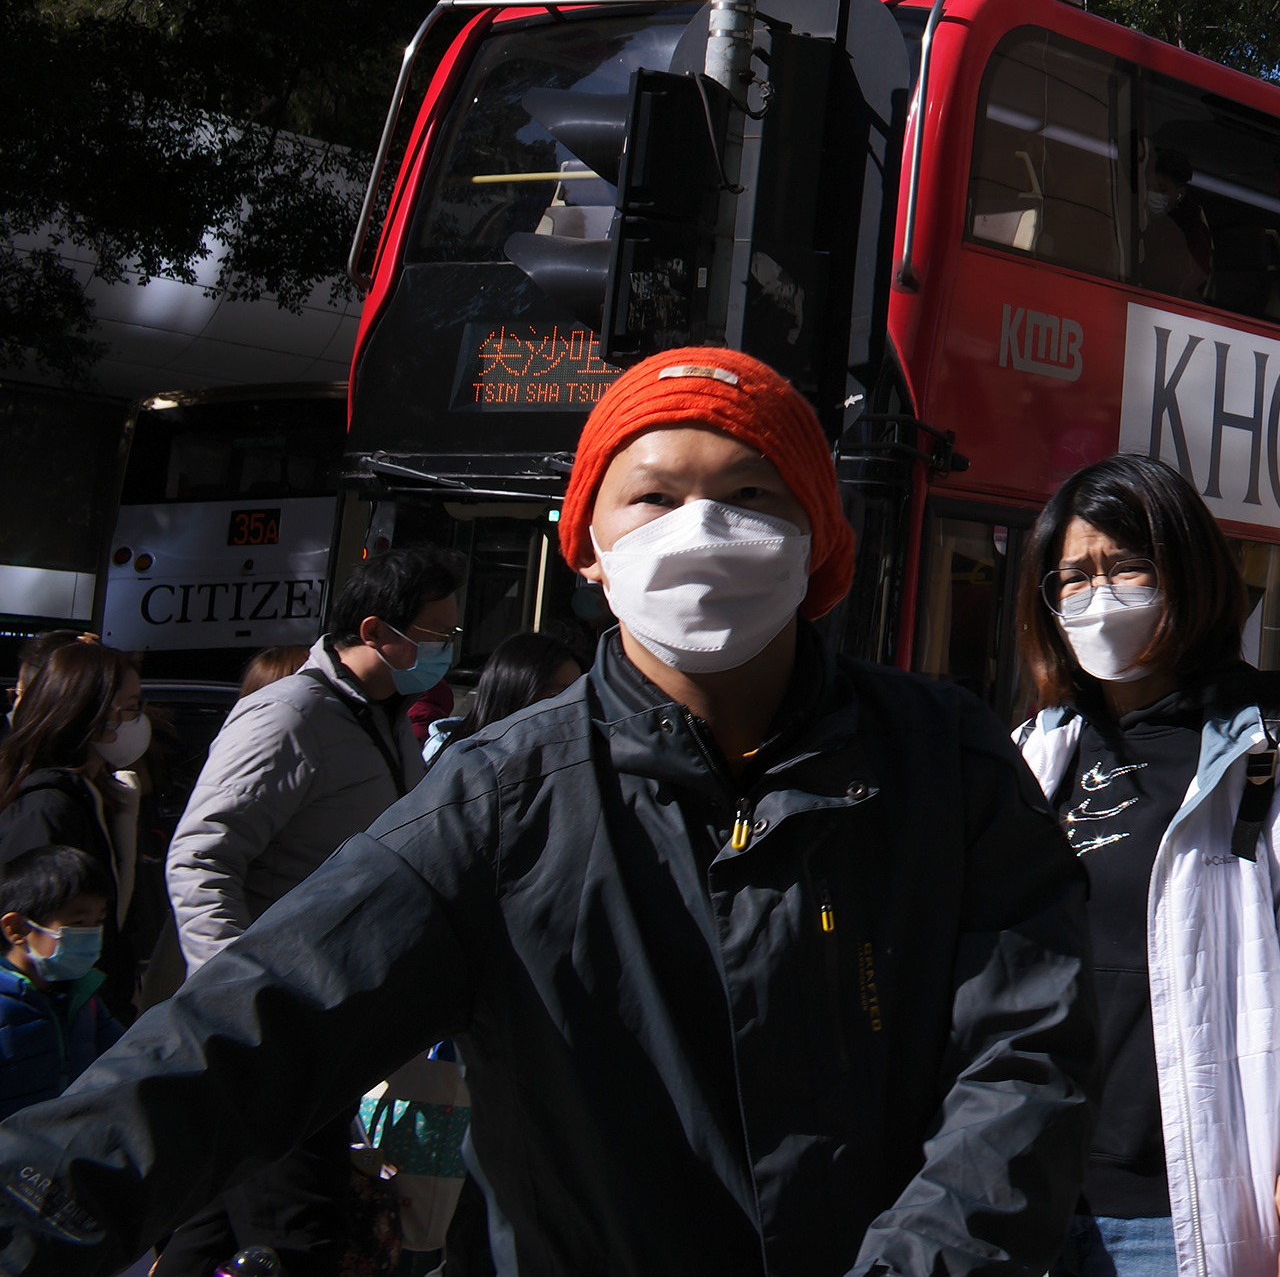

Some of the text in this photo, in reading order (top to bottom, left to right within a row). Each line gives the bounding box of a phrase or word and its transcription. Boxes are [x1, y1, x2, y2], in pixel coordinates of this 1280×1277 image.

[473, 383, 518, 402] TSIM
[526, 383, 560, 402] SHA
[233, 513, 278, 545] 35A
